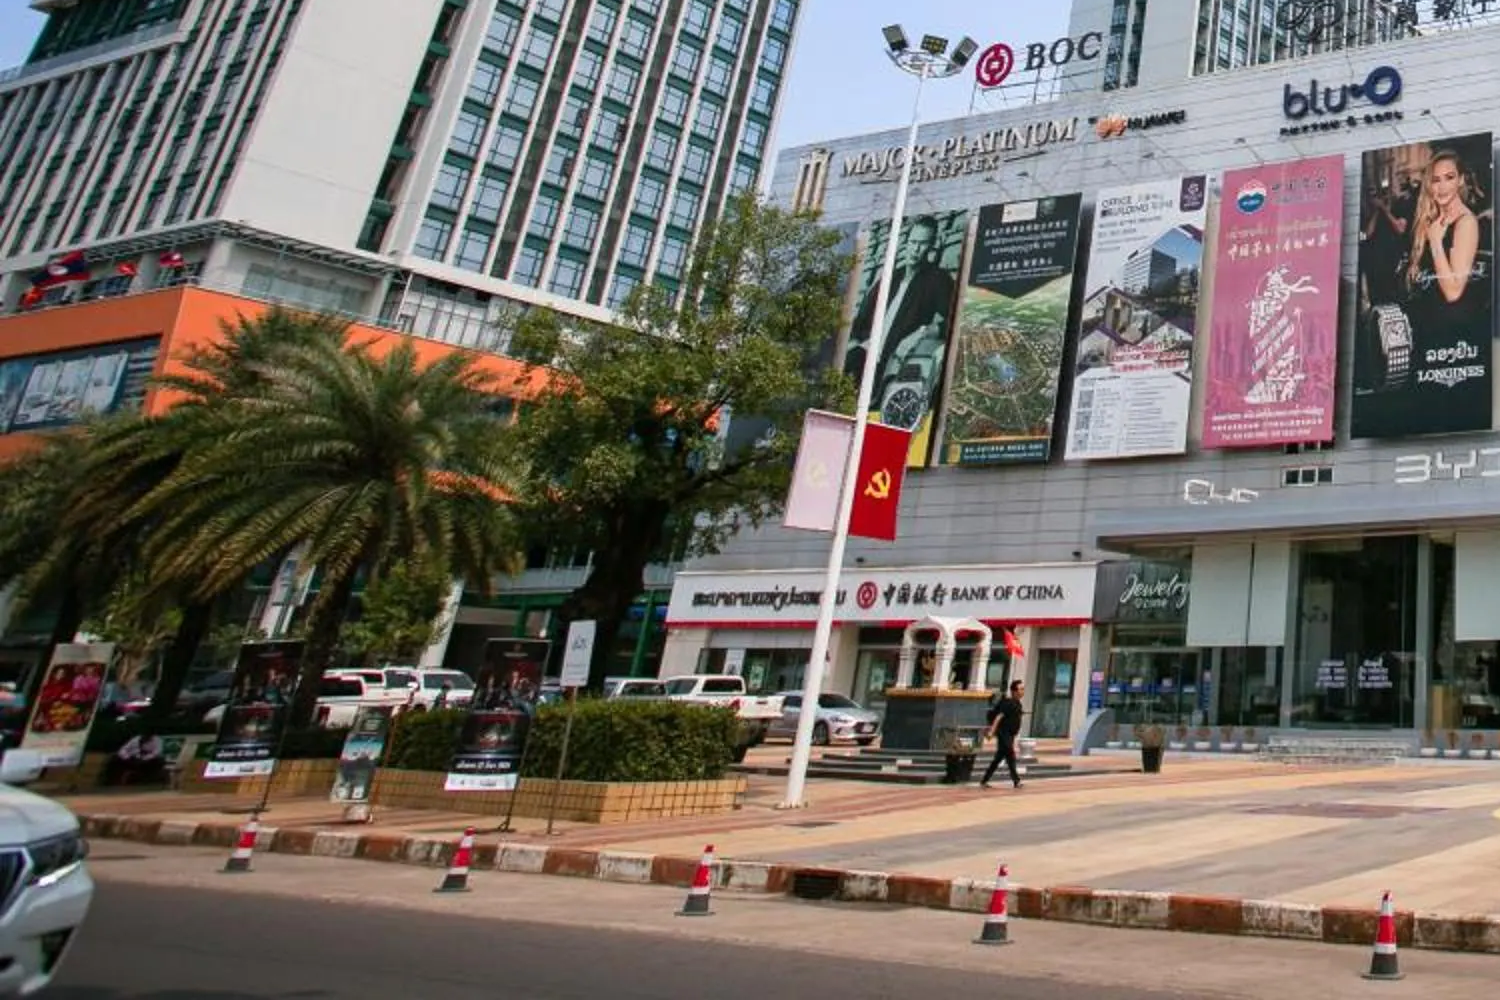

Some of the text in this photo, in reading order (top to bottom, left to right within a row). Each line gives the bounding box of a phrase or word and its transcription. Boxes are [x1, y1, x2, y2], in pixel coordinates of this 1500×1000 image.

[1024, 31, 1103, 71] BOC
[940, 116, 1079, 162] PLATINUM
[1417, 365, 1485, 383] LONGINES
[951, 583, 1064, 600] BANK OF CHINA
